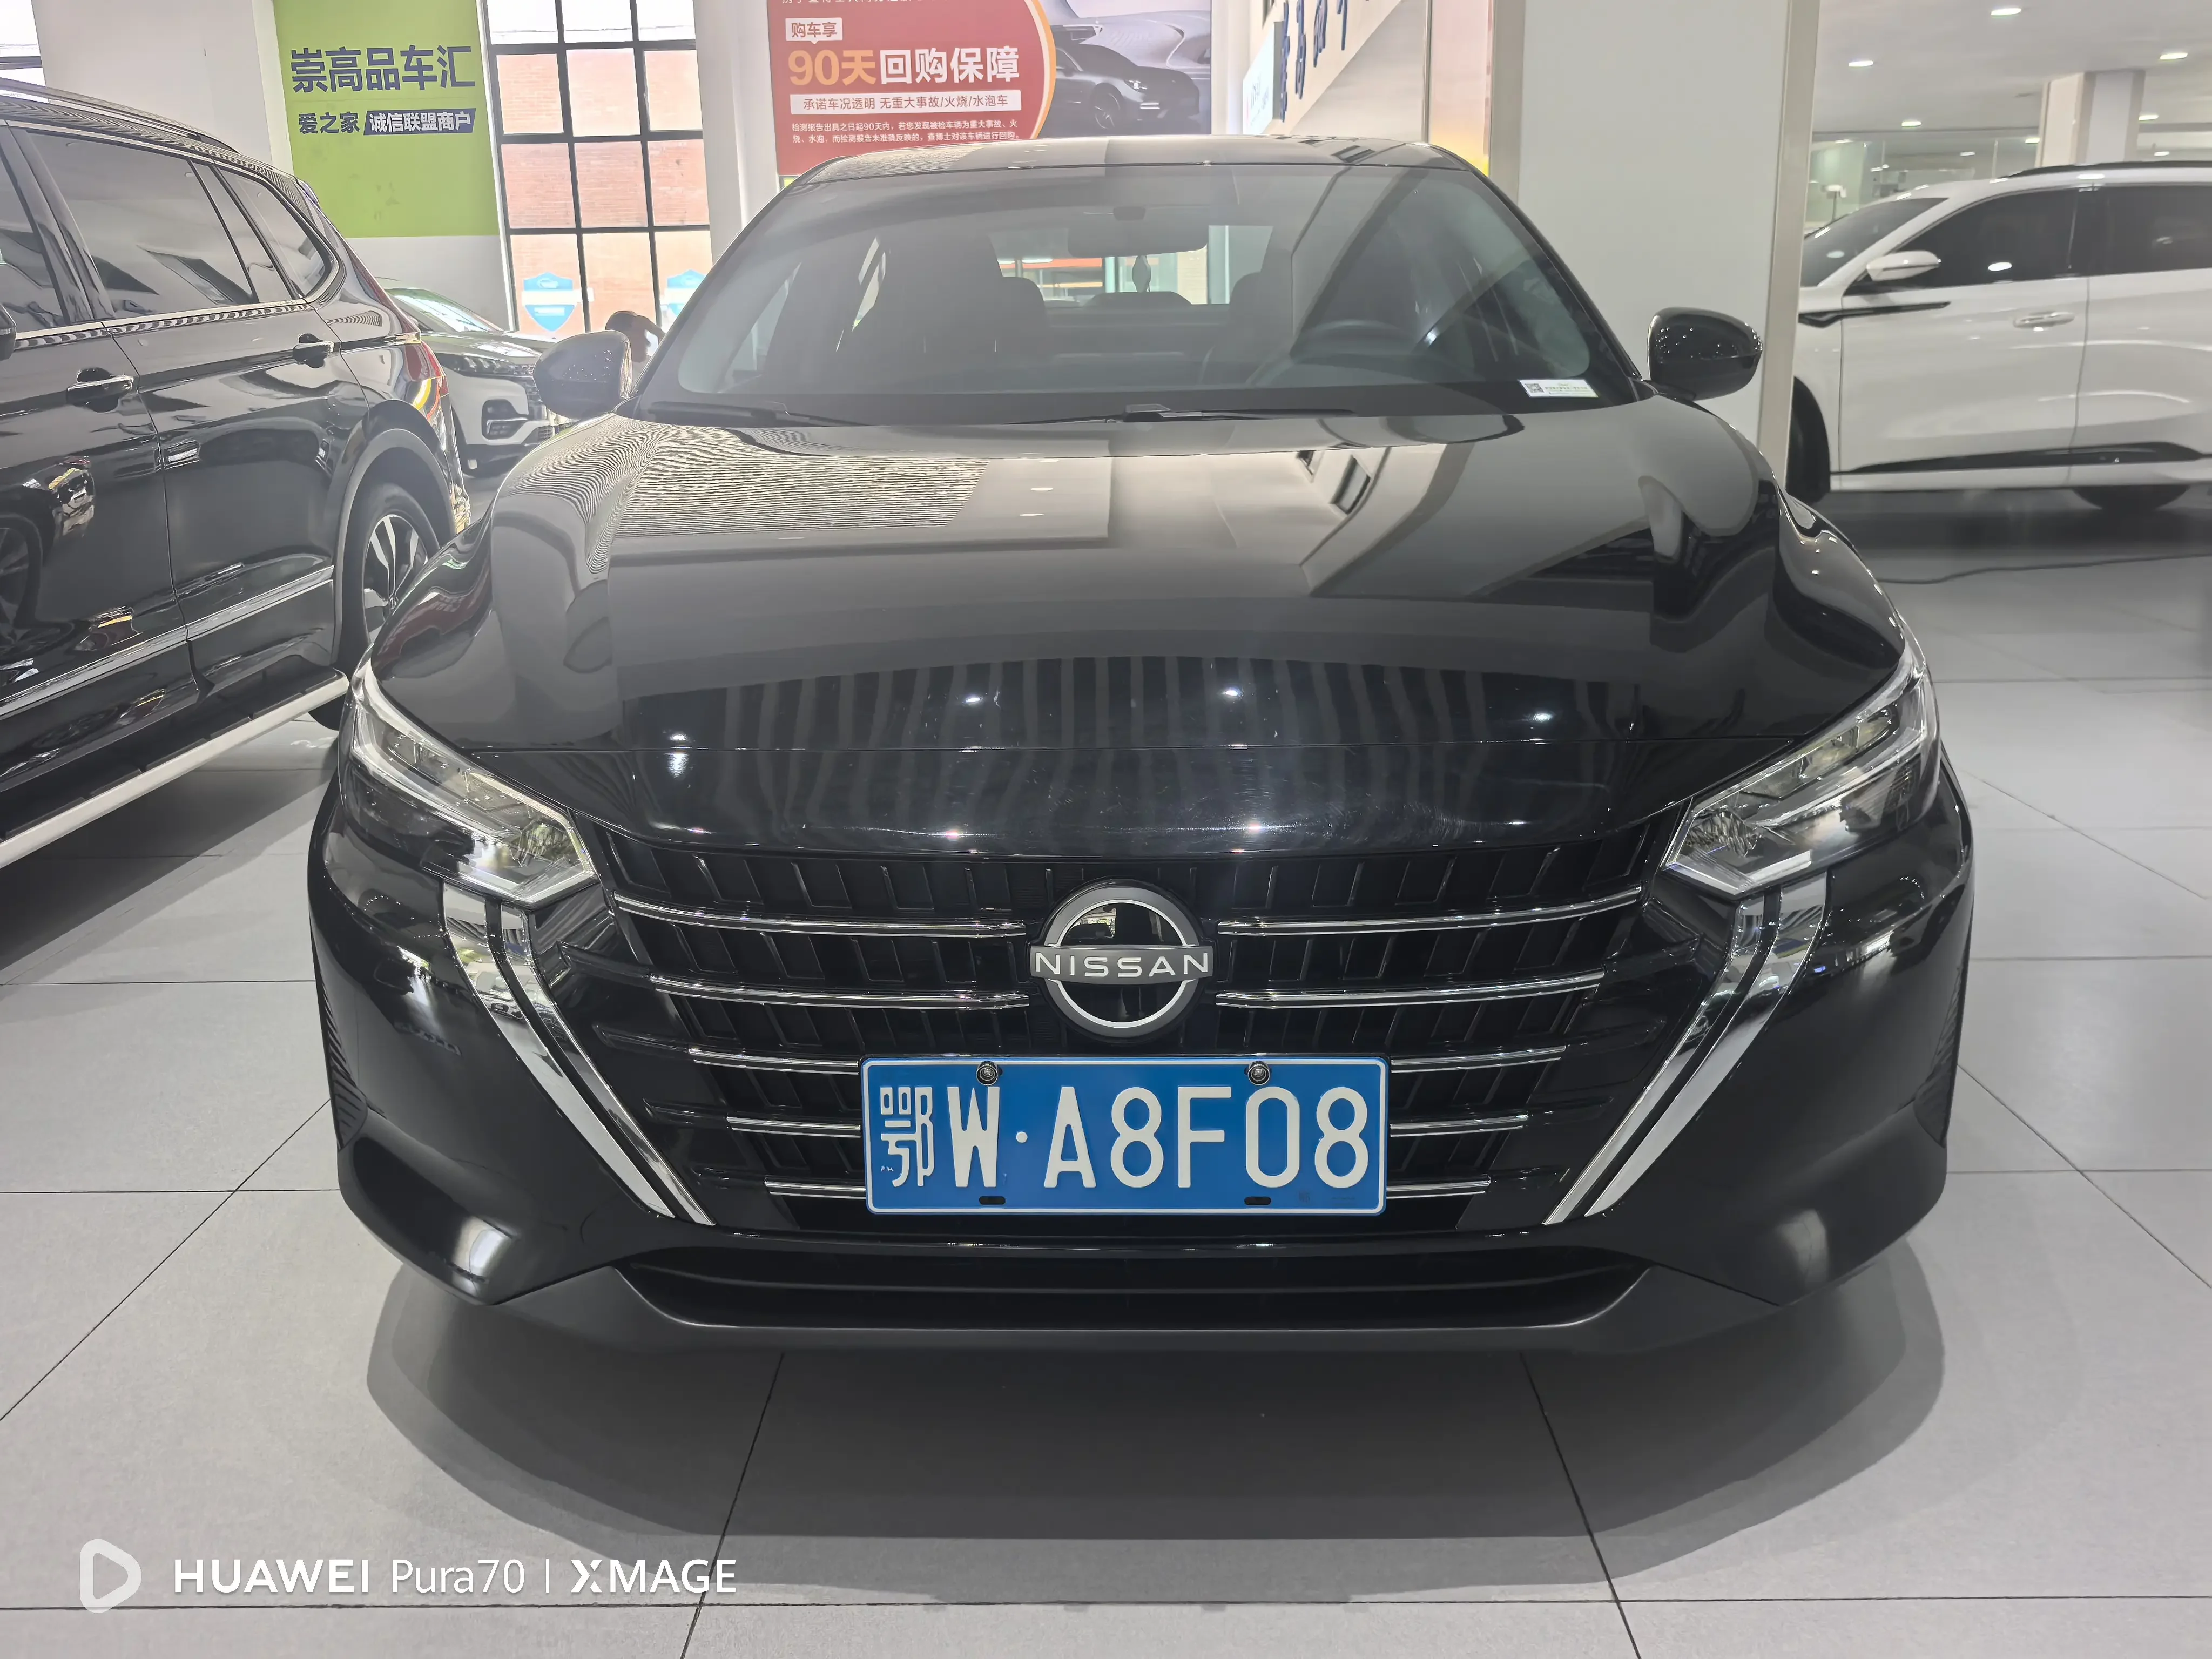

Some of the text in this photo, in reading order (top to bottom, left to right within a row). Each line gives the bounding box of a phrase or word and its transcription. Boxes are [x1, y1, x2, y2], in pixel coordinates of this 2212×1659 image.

[791, 22, 837, 38] 购车享
[291, 45, 475, 93] 崇高品车汇
[788, 45, 1020, 85] 90天回购保障
[804, 95, 1009, 110] 承诺车况透明 无重大事故/火烧/水泡车
[298, 111, 471, 134] 爱之家 诚信联盟商户
[1035, 952, 1210, 978] NISSAN
